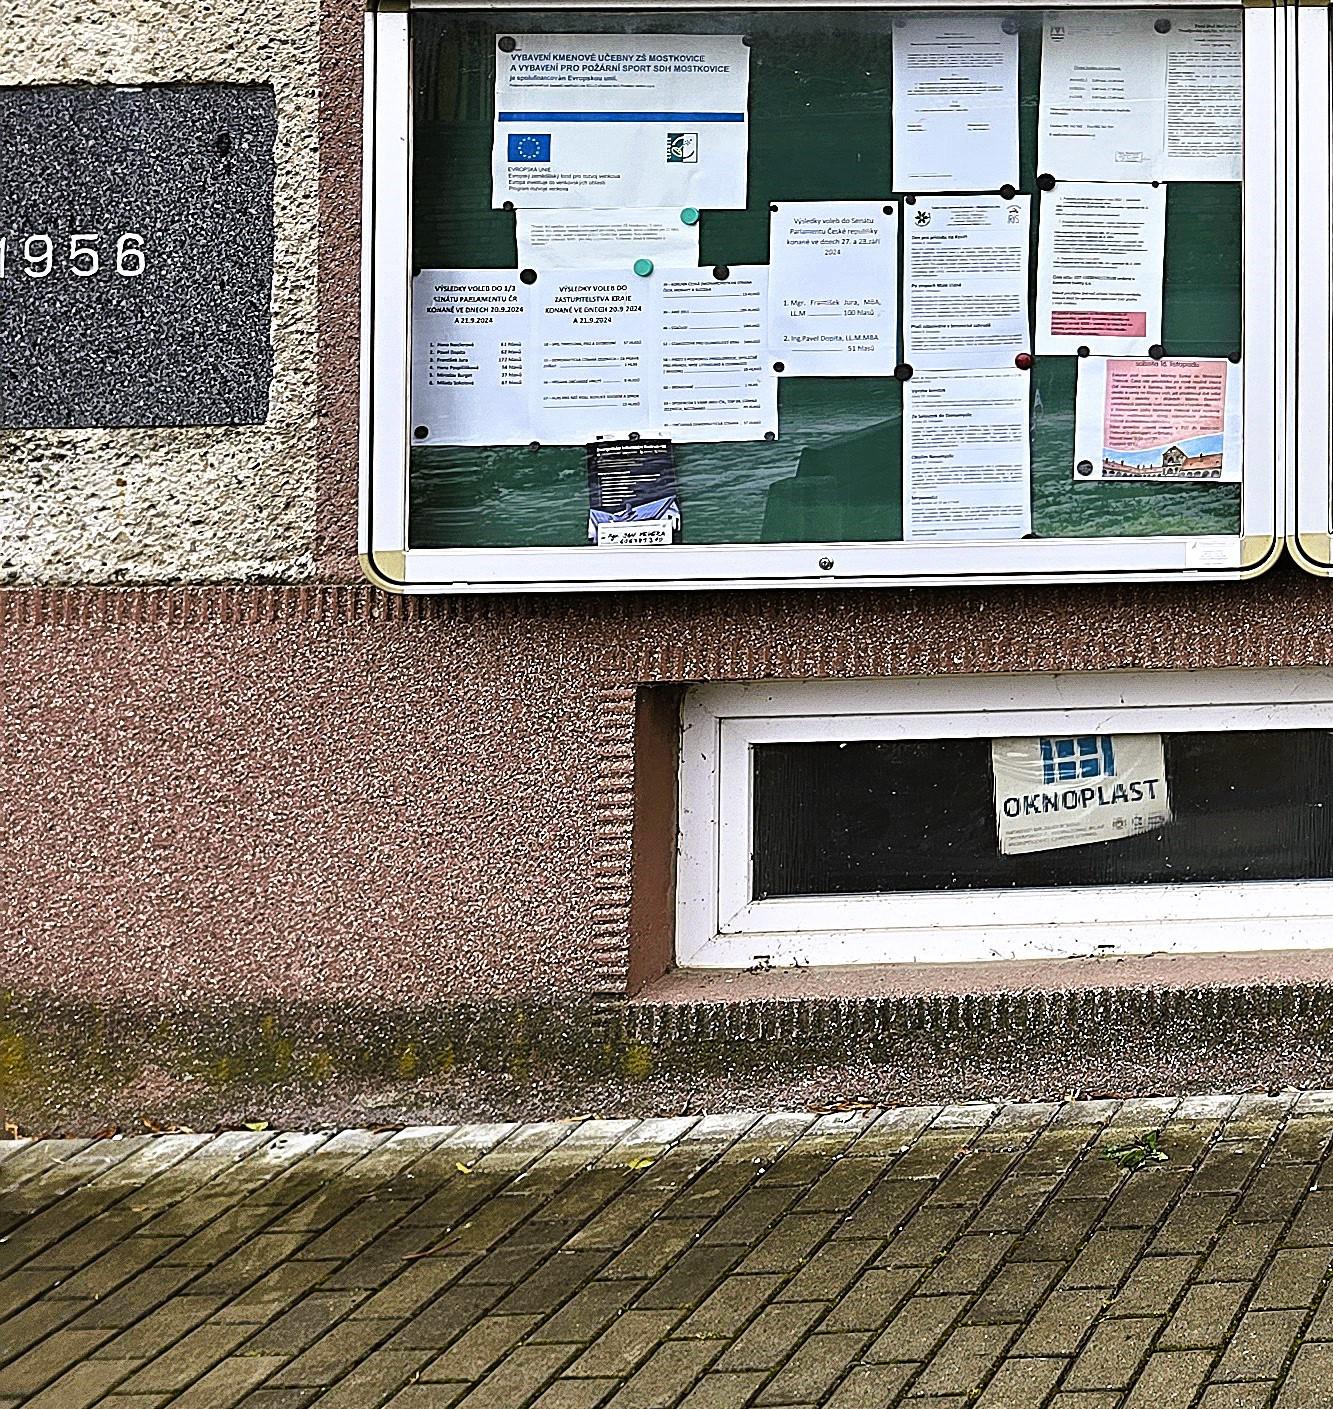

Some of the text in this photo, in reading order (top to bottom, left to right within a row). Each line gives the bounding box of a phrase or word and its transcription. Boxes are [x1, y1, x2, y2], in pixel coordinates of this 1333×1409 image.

[511, 53, 551, 62] VYBAVENÍ
[553, 53, 596, 62] KMENOVÉ
[598, 53, 634, 62] UČEBNY
[519, 64, 558, 72] VYBAVENÍ
[582, 63, 620, 72] POŽÁRNÍ
[674, 65, 730, 73] MOSTKOVICE
[0, 233, 146, 278] 1956
[1003, 778, 1160, 818] OKNOPLAST
